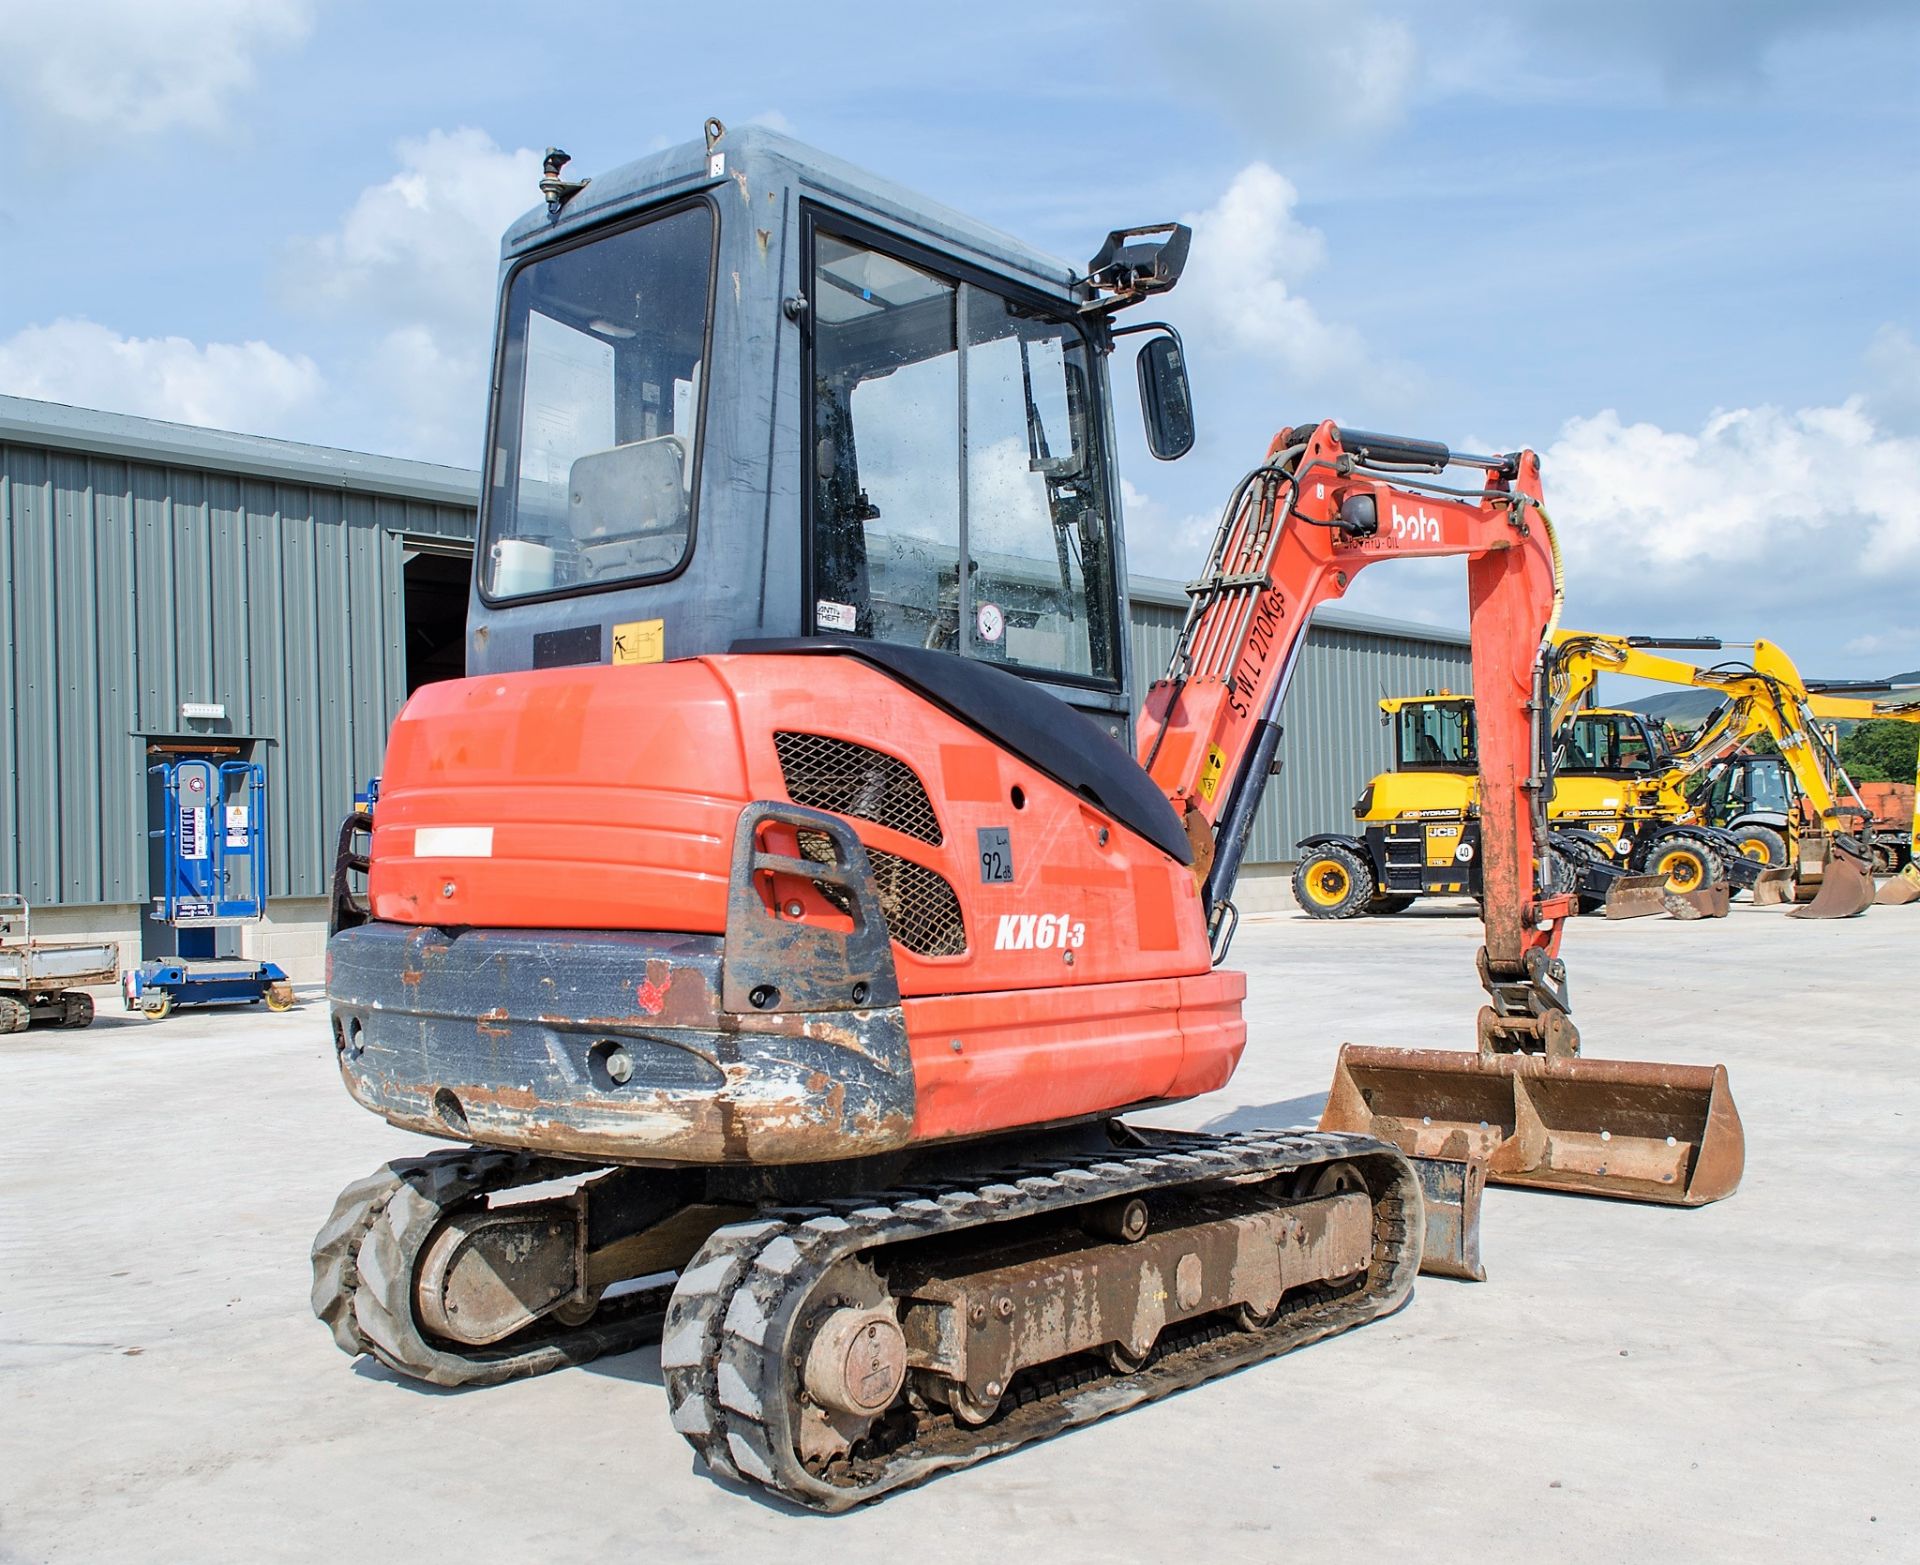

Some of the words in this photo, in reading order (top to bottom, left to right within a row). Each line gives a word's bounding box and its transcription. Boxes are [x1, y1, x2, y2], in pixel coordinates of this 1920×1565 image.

[1392, 504, 1440, 542] bota
[816, 612, 841, 623] THEFT
[1429, 827, 1457, 837] JCB
[1591, 825, 1618, 834] JCB
[1459, 847, 1469, 857] 40
[1620, 842, 1628, 852] 40
[982, 851, 1003, 880] 92
[1002, 865, 1012, 880] dB
[993, 913, 1086, 951] KX61-3
